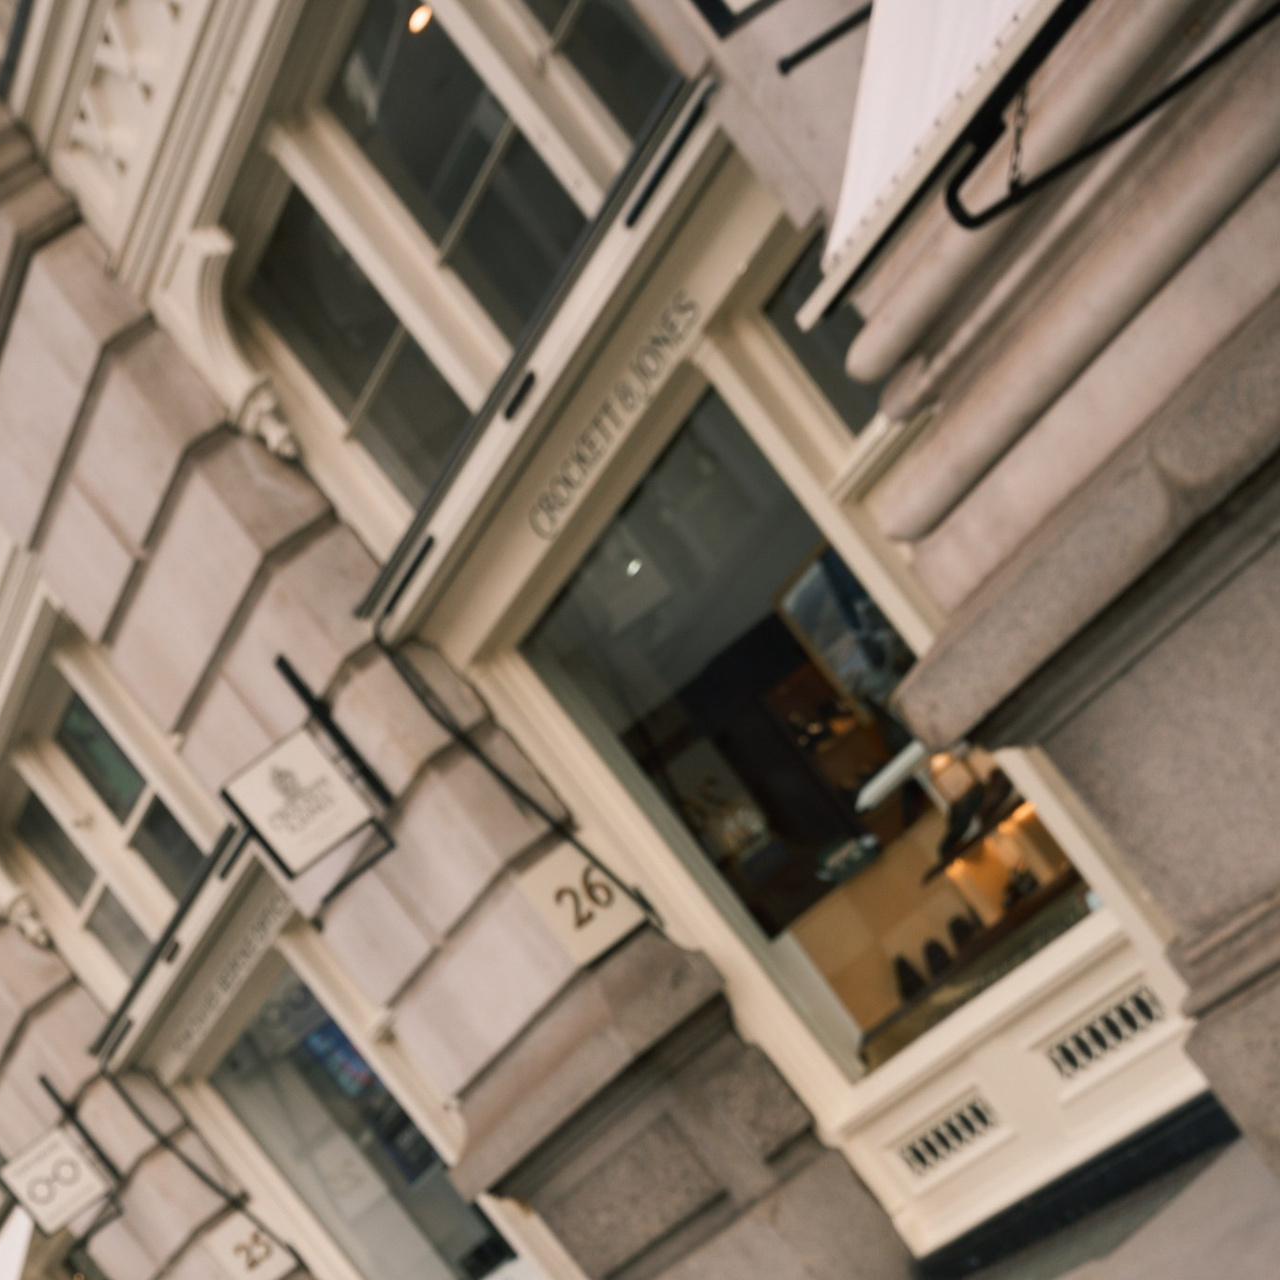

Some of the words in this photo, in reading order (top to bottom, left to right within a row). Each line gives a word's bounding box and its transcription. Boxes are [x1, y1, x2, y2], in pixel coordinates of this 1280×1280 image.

[529, 398, 625, 540] CROCKETT
[615, 379, 640, 414] &
[631, 290, 699, 402] JONES
[555, 864, 614, 930] 26
[234, 1231, 272, 1272] 25
